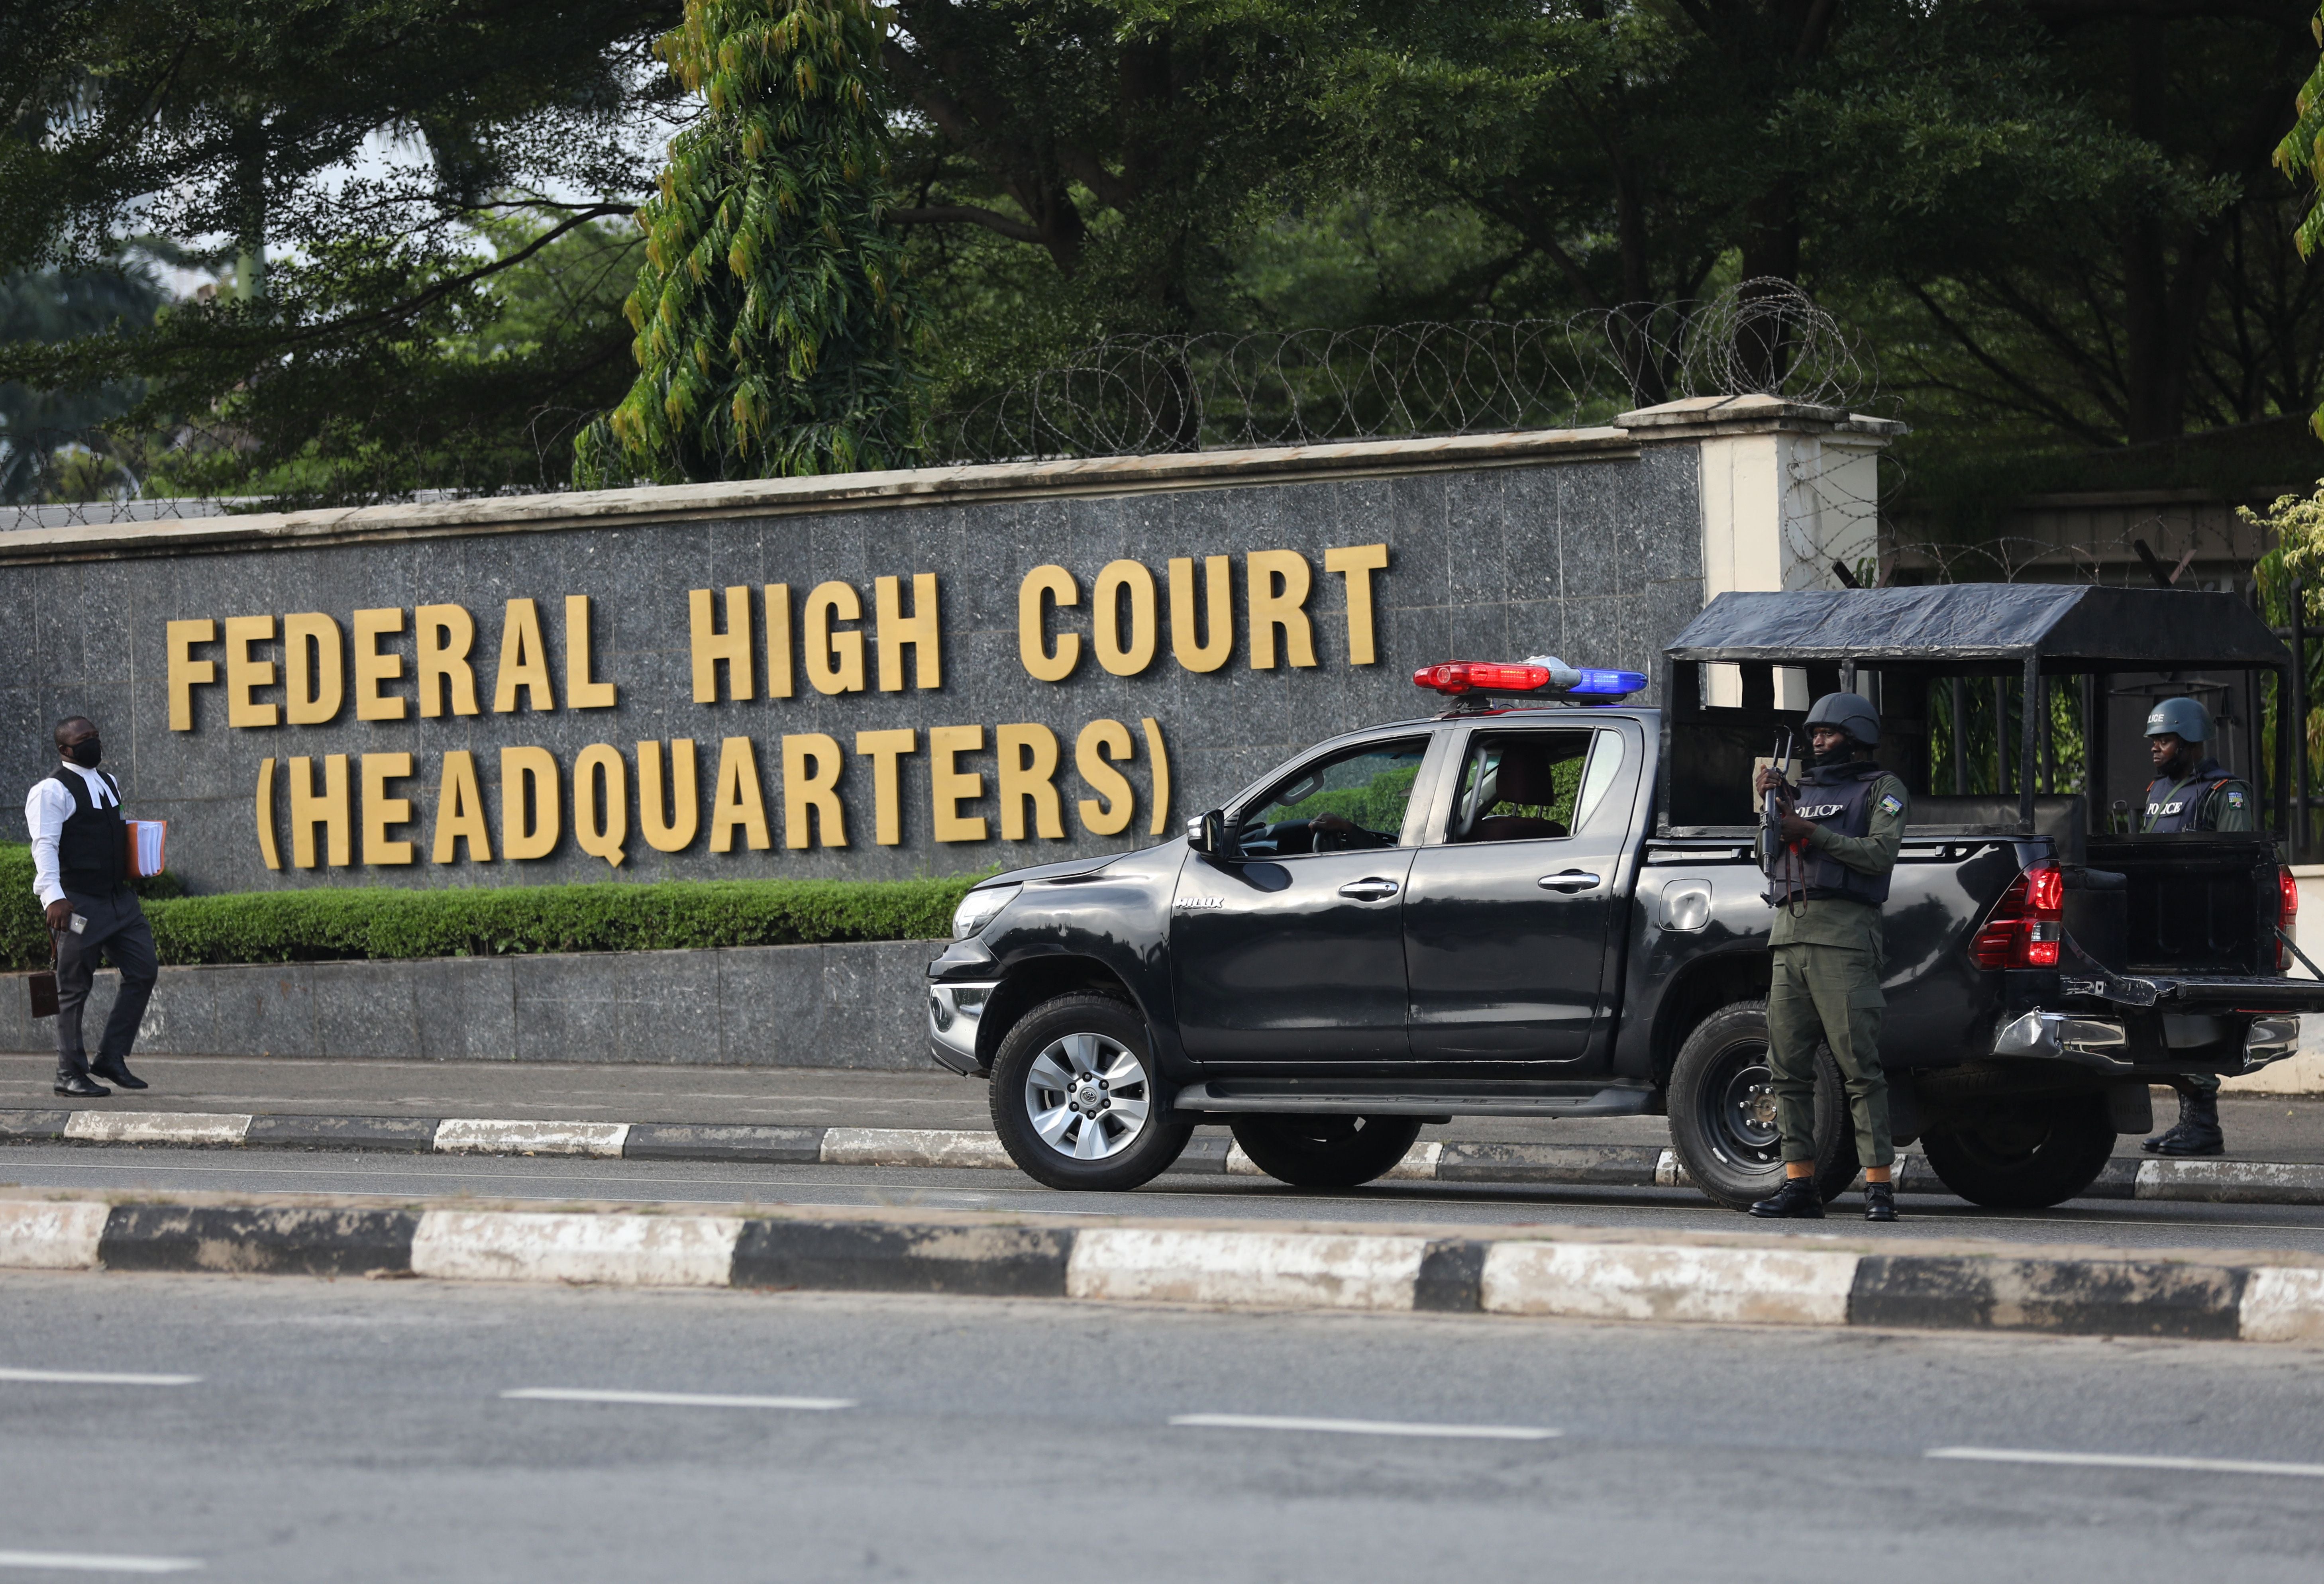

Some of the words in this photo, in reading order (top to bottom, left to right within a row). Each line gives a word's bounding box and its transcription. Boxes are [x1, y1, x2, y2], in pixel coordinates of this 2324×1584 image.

[166, 594, 616, 731] FEDERAL
[688, 572, 941, 704] HIGH
[1018, 543, 1388, 682] COURT
[2147, 714, 2164, 723] LICE
[255, 717, 1170, 870] (HEADQUARTERS)
[1795, 804, 1843, 818] OLICE
[1176, 897, 1224, 909] HILUX
